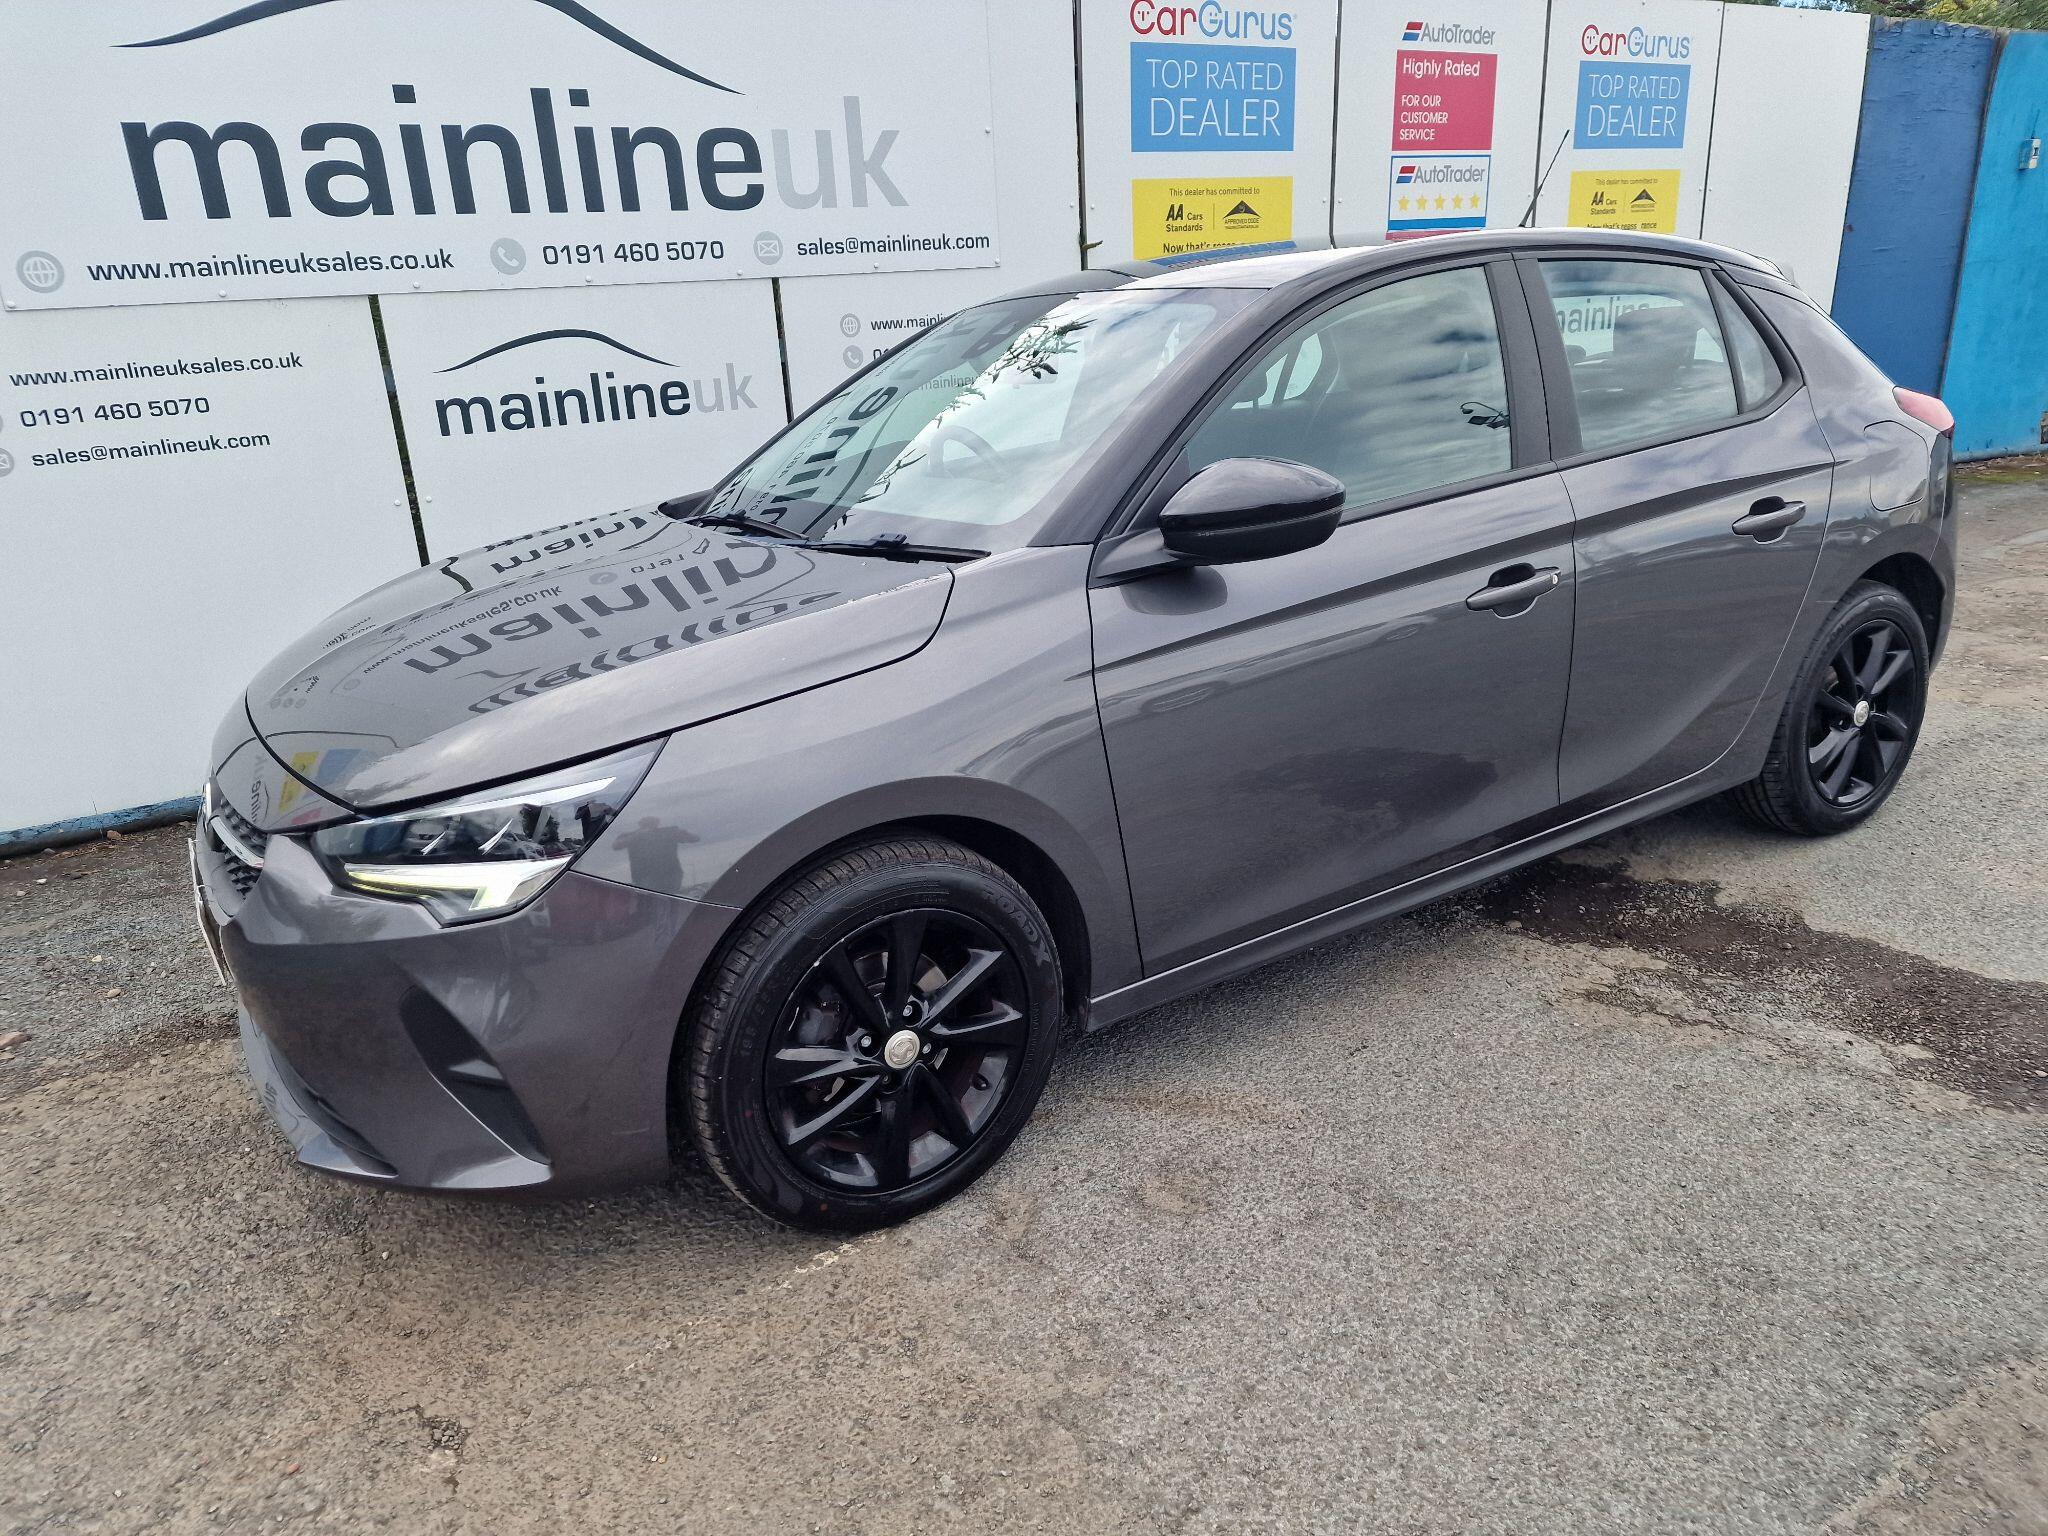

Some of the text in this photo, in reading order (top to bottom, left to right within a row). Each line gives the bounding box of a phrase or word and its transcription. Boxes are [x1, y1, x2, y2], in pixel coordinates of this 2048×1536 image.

[1130, 0, 1293, 40] CarGurus
[1421, 22, 1496, 45] AutoTrader
[1582, 24, 1690, 58] CarGurus
[1146, 59, 1283, 91] TOP RATED
[1403, 57, 1480, 78] Highly Rated
[1589, 74, 1681, 99] TOP RATED
[1401, 95, 1442, 107] FOR OUR
[1150, 97, 1281, 136] DEALER
[1400, 112, 1449, 124] CUSTOMER
[1587, 105, 1677, 137] DEALER
[1399, 129, 1436, 141] SERVICE
[1413, 165, 1486, 184] AutoTrader
[1169, 188, 1183, 197] This
[1184, 188, 1205, 196] dealer
[1218, 186, 1253, 195] committed
[1591, 191, 1604, 205] AA
[1166, 203, 1203, 222] AA Cars
[1165, 223, 1203, 233] Standards
[542, 240, 725, 265] 0191 460 5070
[797, 232, 991, 257] sales@mainlineuk.com
[1162, 243, 1185, 254] Now
[87, 248, 455, 282] www.mainlineuksales.co.uk
[9, 352, 304, 387] www.mainlineuksales.co.uk
[20, 397, 210, 428] 0191 460 5070
[32, 433, 271, 467] sales@mainlineuk.com
